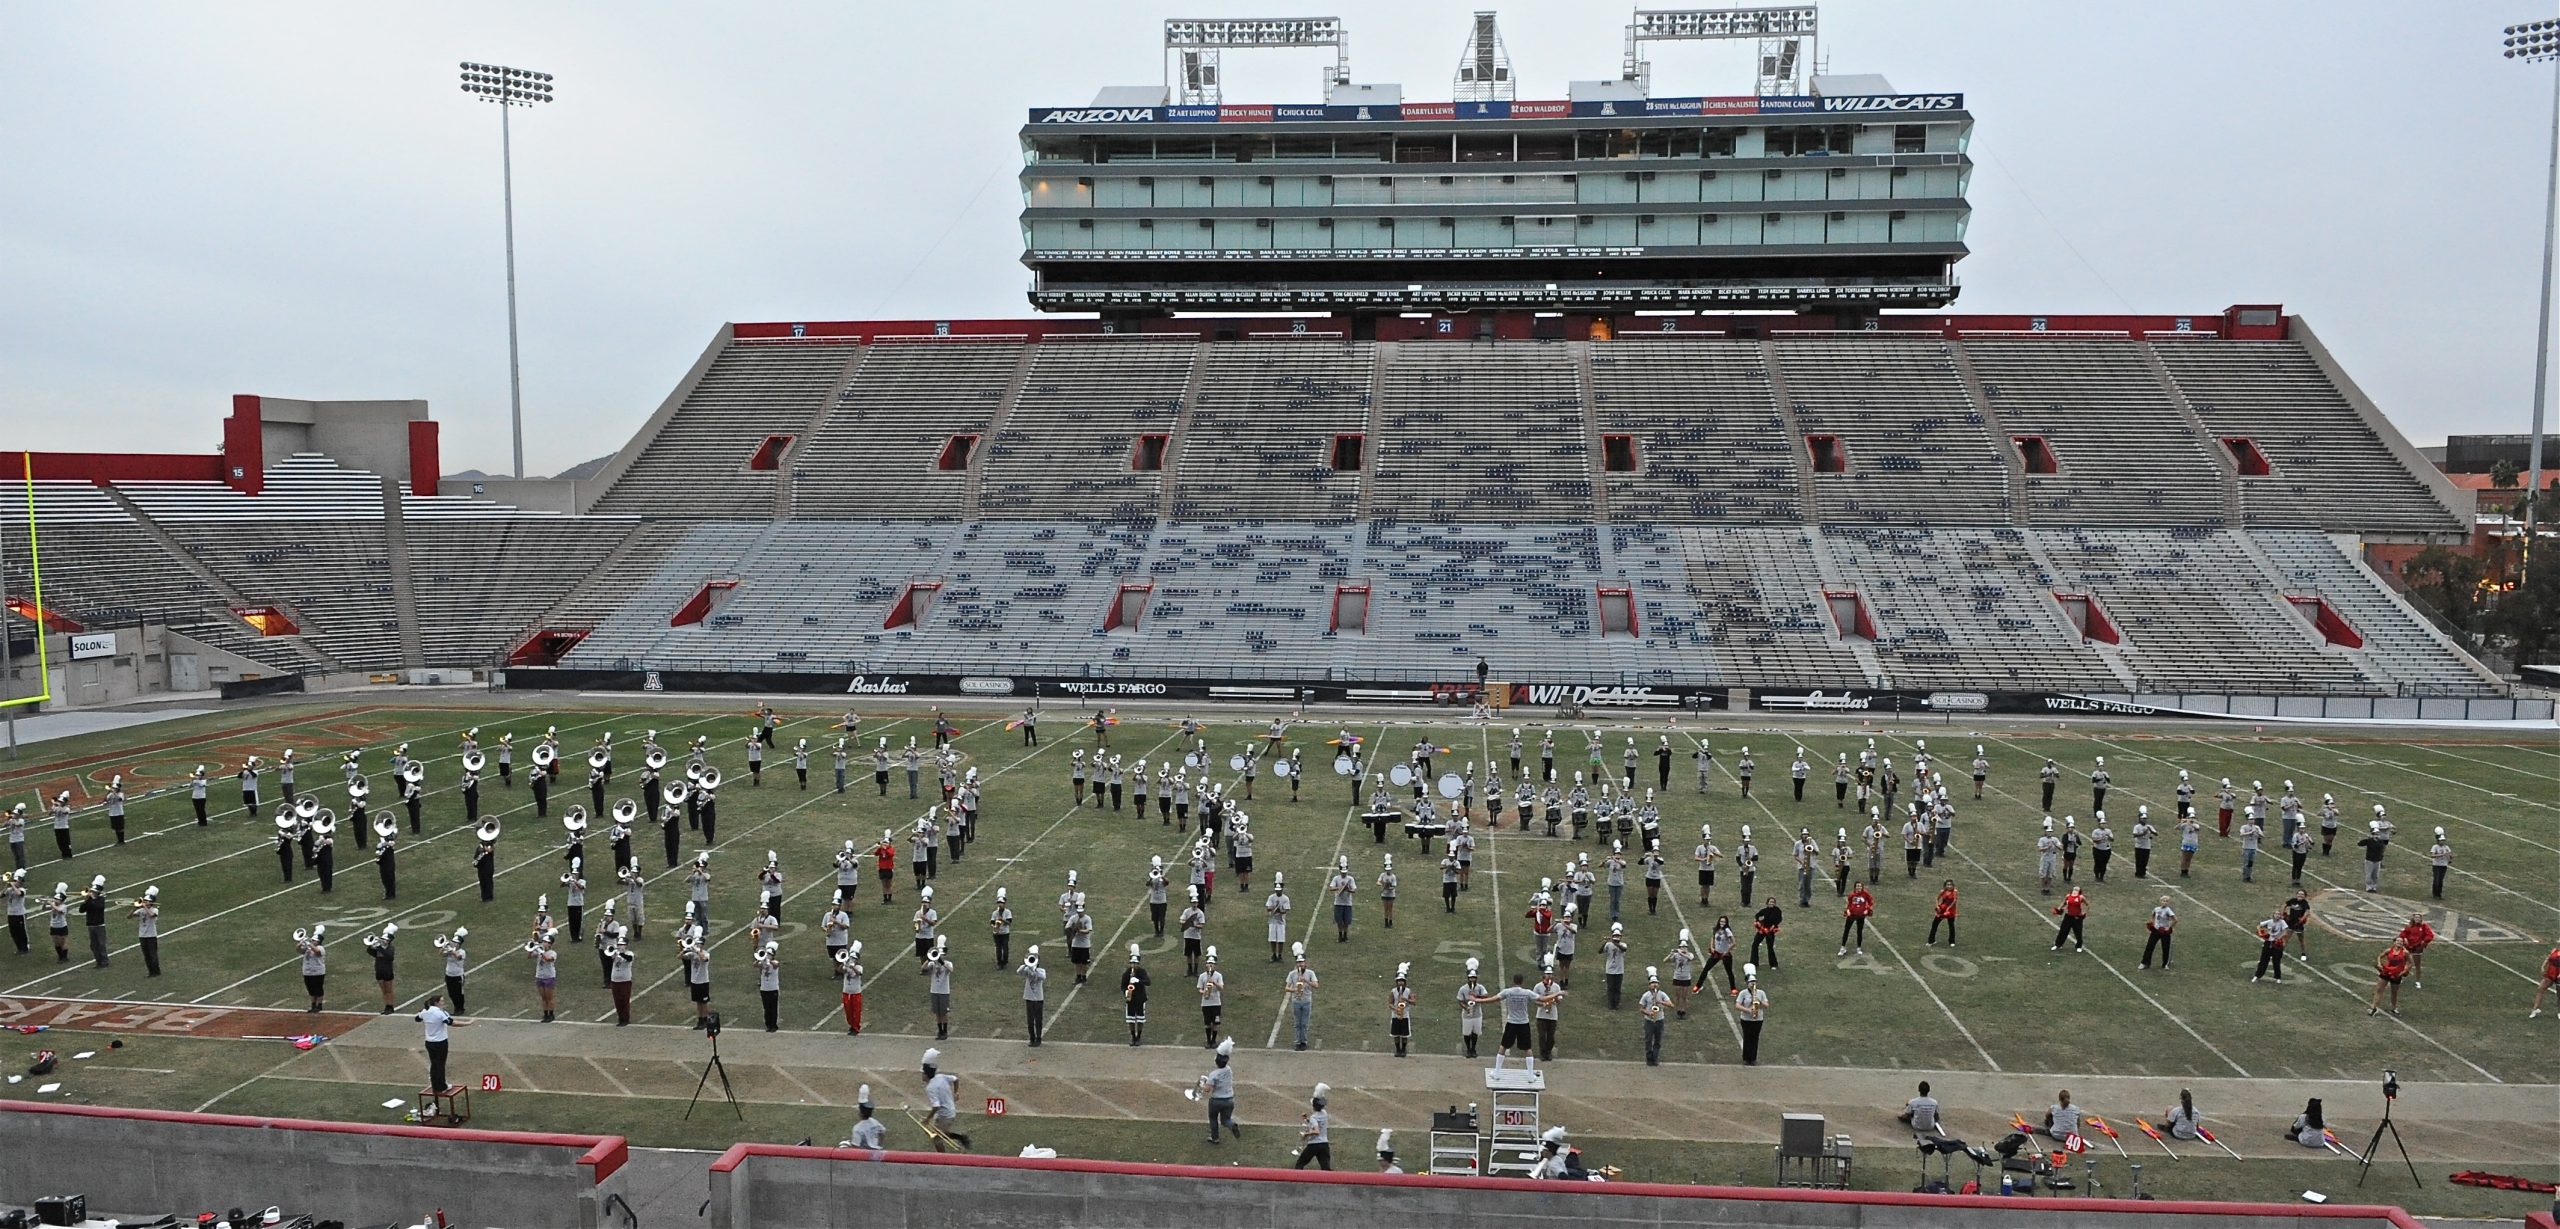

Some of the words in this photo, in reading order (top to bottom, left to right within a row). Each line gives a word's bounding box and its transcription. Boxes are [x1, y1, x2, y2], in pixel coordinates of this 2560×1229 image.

[1646, 102, 1654, 110] 28
[1654, 102, 1668, 110] STEVE
[1669, 102, 1702, 110] McLAUGHLIN
[1709, 101, 1726, 109] CHRIS
[1727, 101, 1758, 109] McALISTER
[1824, 96, 1955, 111] WILDCATS
[1168, 109, 1176, 118] 22
[1177, 109, 1188, 118] ART
[1189, 109, 1216, 118] LUPPINO
[1283, 108, 1305, 117] CHUCK
[1306, 108, 1323, 117] CECIL
[1357, 107, 1371, 120] A
[1407, 108, 1434, 116] DARRYLL
[1435, 108, 1455, 116] LEWIS
[1520, 105, 1533, 113] ROB
[1534, 105, 1565, 113] WALDROP
[1041, 109, 1153, 123] ARIZONA
[937, 327, 948, 335] 18
[1104, 326, 1113, 334] 19
[1293, 324, 1306, 333] 20
[1440, 323, 1451, 332] 21
[1663, 322, 1675, 331] 22
[1866, 322, 1878, 331] 23
[2032, 323, 2046, 331] 24
[2177, 323, 2190, 331] 25
[794, 329, 804, 337] 17
[233, 469, 243, 477] 15
[474, 484, 483, 493] 16
[74, 641, 101, 652] SOLON
[644, 672, 663, 691] A
[847, 676, 909, 694] Bashas'
[965, 682, 978, 690] SOL
[980, 682, 1009, 690] CASINOS
[1068, 683, 1115, 694] WELLS
[1118, 683, 1166, 694] FARGO
[1950, 697, 1983, 705] CASINOS
[2045, 698, 2098, 710] WELLS
[483, 1074, 499, 1091] 30
[988, 1100, 1003, 1114] 40
[1506, 1111, 1521, 1125] 50
[2065, 1134, 2082, 1152] 40
